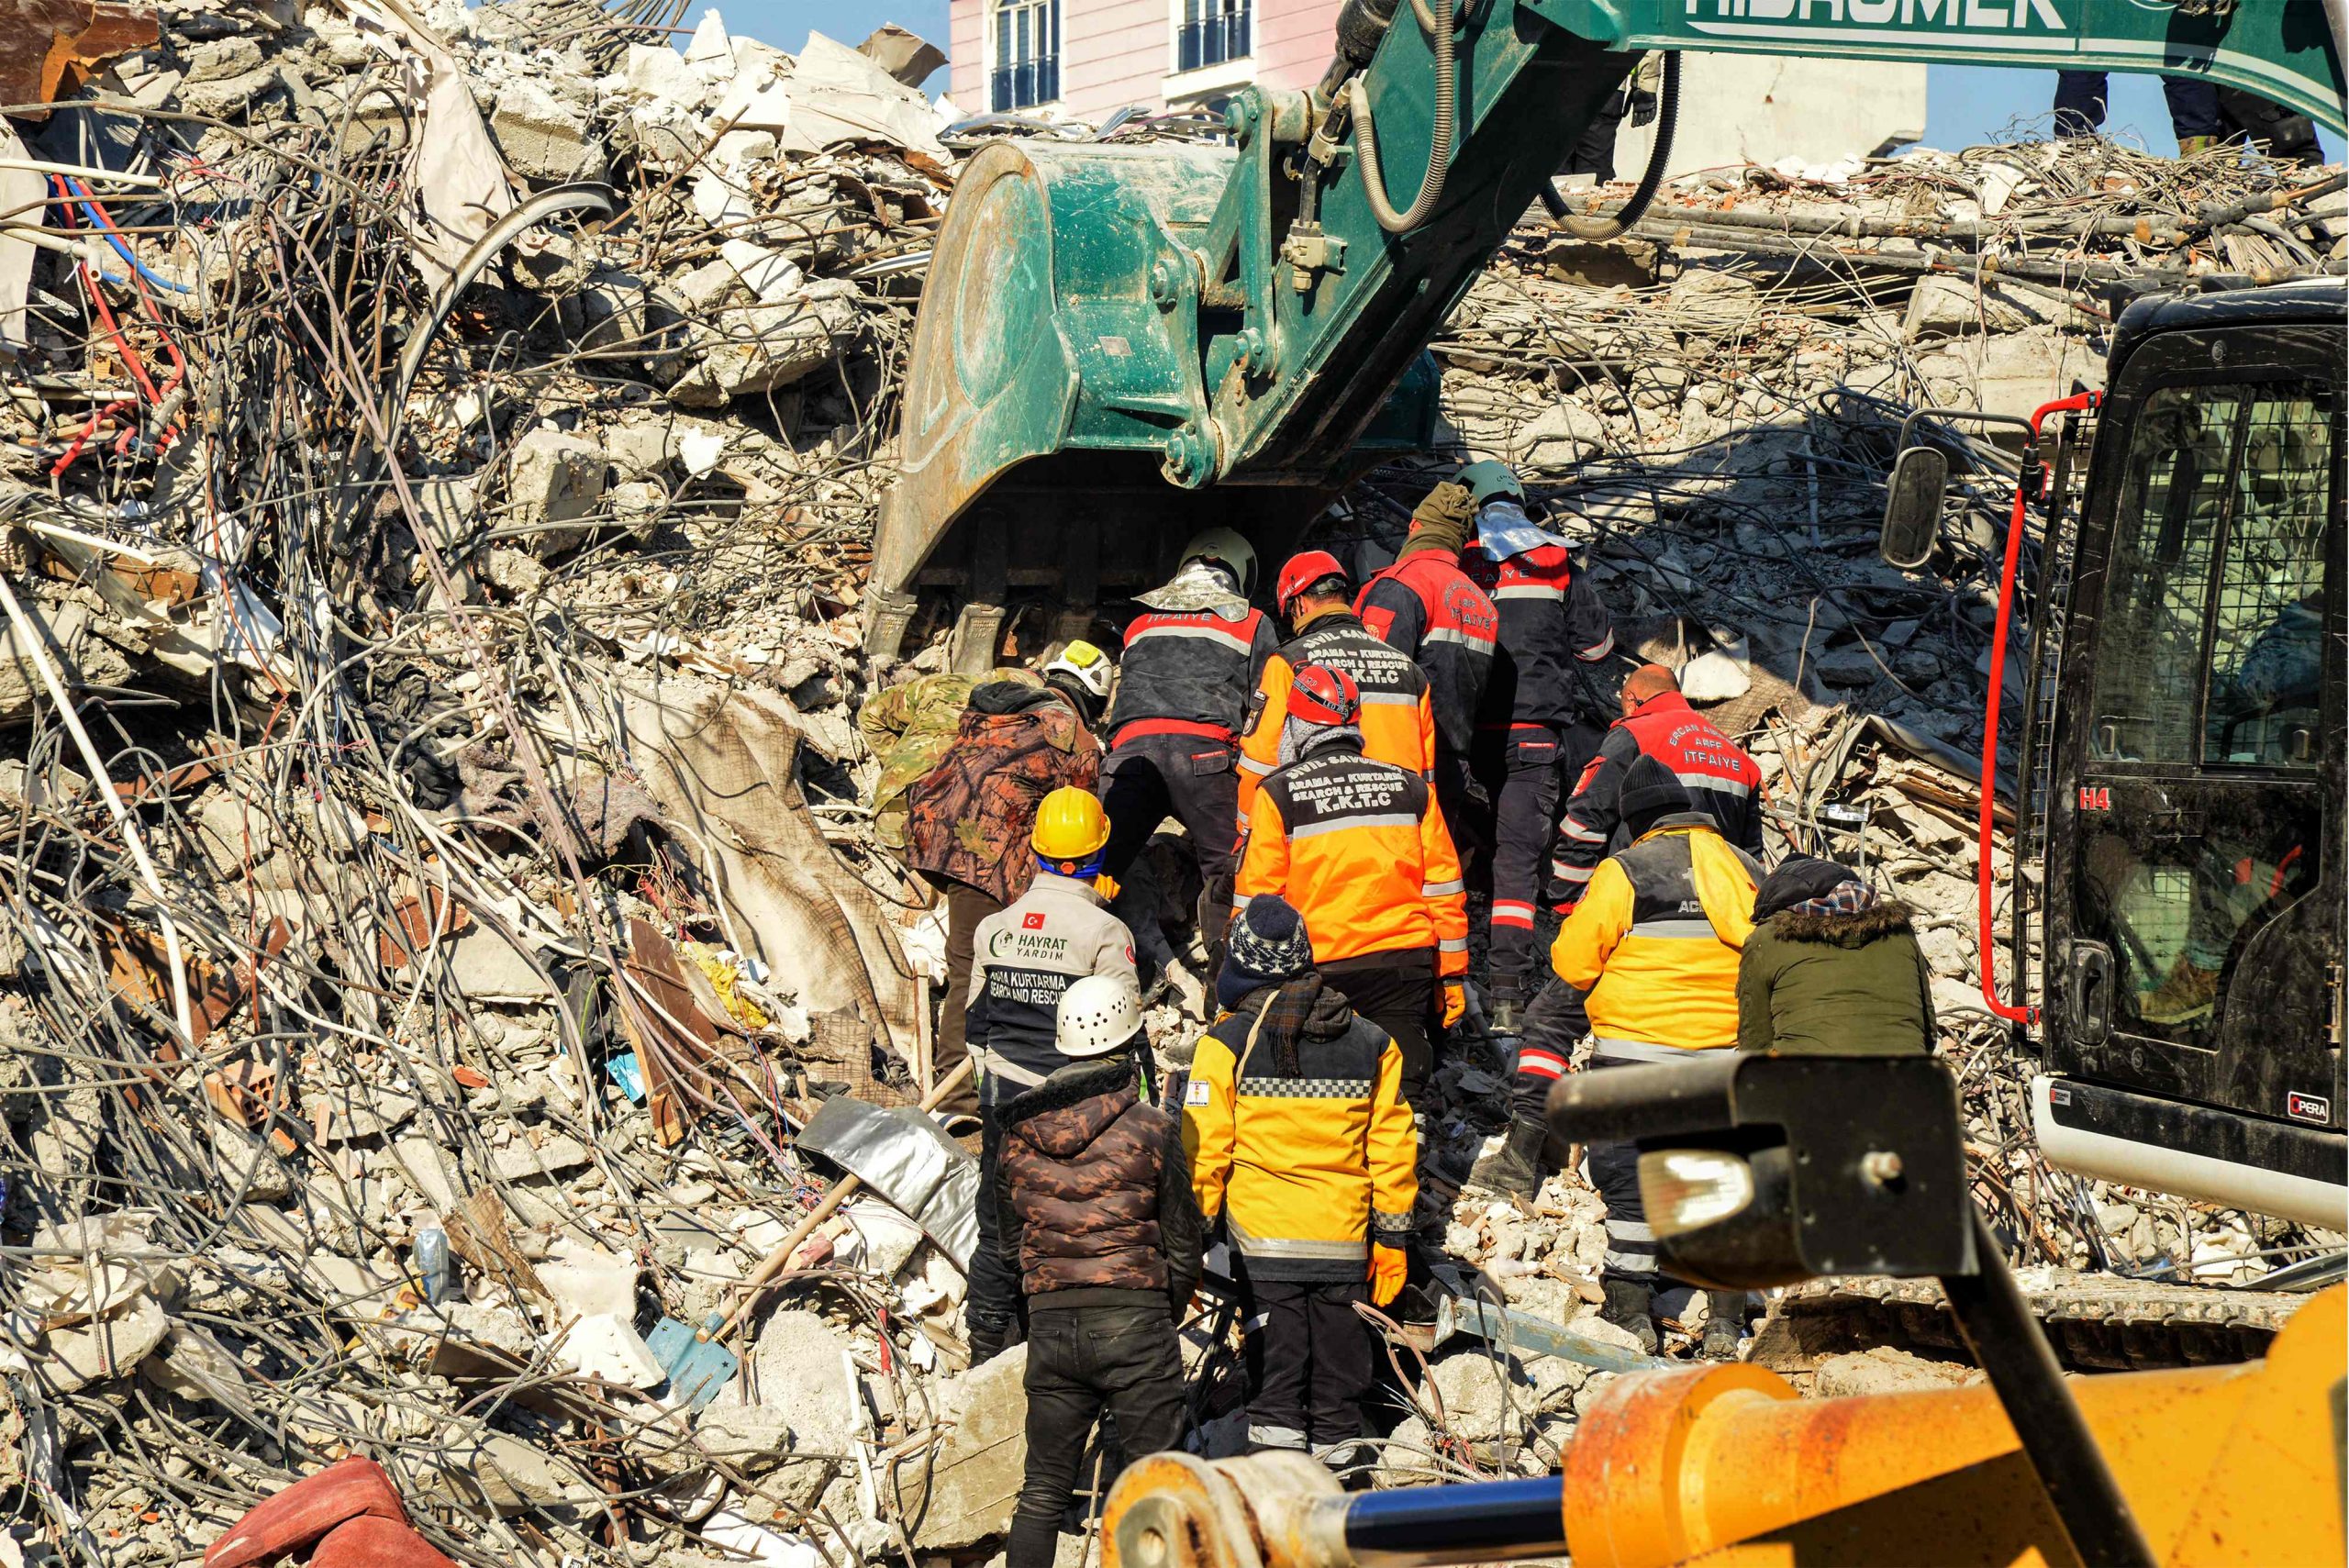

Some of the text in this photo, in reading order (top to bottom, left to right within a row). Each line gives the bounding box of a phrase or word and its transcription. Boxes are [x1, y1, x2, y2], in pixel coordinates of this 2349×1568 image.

[1308, 649, 1346, 662] ARAMA
[1358, 660, 1365, 668] &
[1367, 661, 1409, 671] RESCUE
[1341, 669, 1399, 684] .K.T.C
[1669, 724, 1699, 746] ERCAN
[1288, 777, 1332, 792] ARAMA
[1292, 782, 1404, 802] SEARCH & RESCUE
[1315, 792, 1392, 814] K.K.T.C
[2079, 786, 2111, 811] H4
[1019, 935, 1067, 950] HAYRAT
[1017, 948, 1063, 961] YARDIM
[1010, 972, 1066, 990] KURTARMA
[990, 981, 1012, 999] SEARCH
[1012, 988, 1029, 1003] AND
[2290, 1095, 2326, 1117] OPERA
